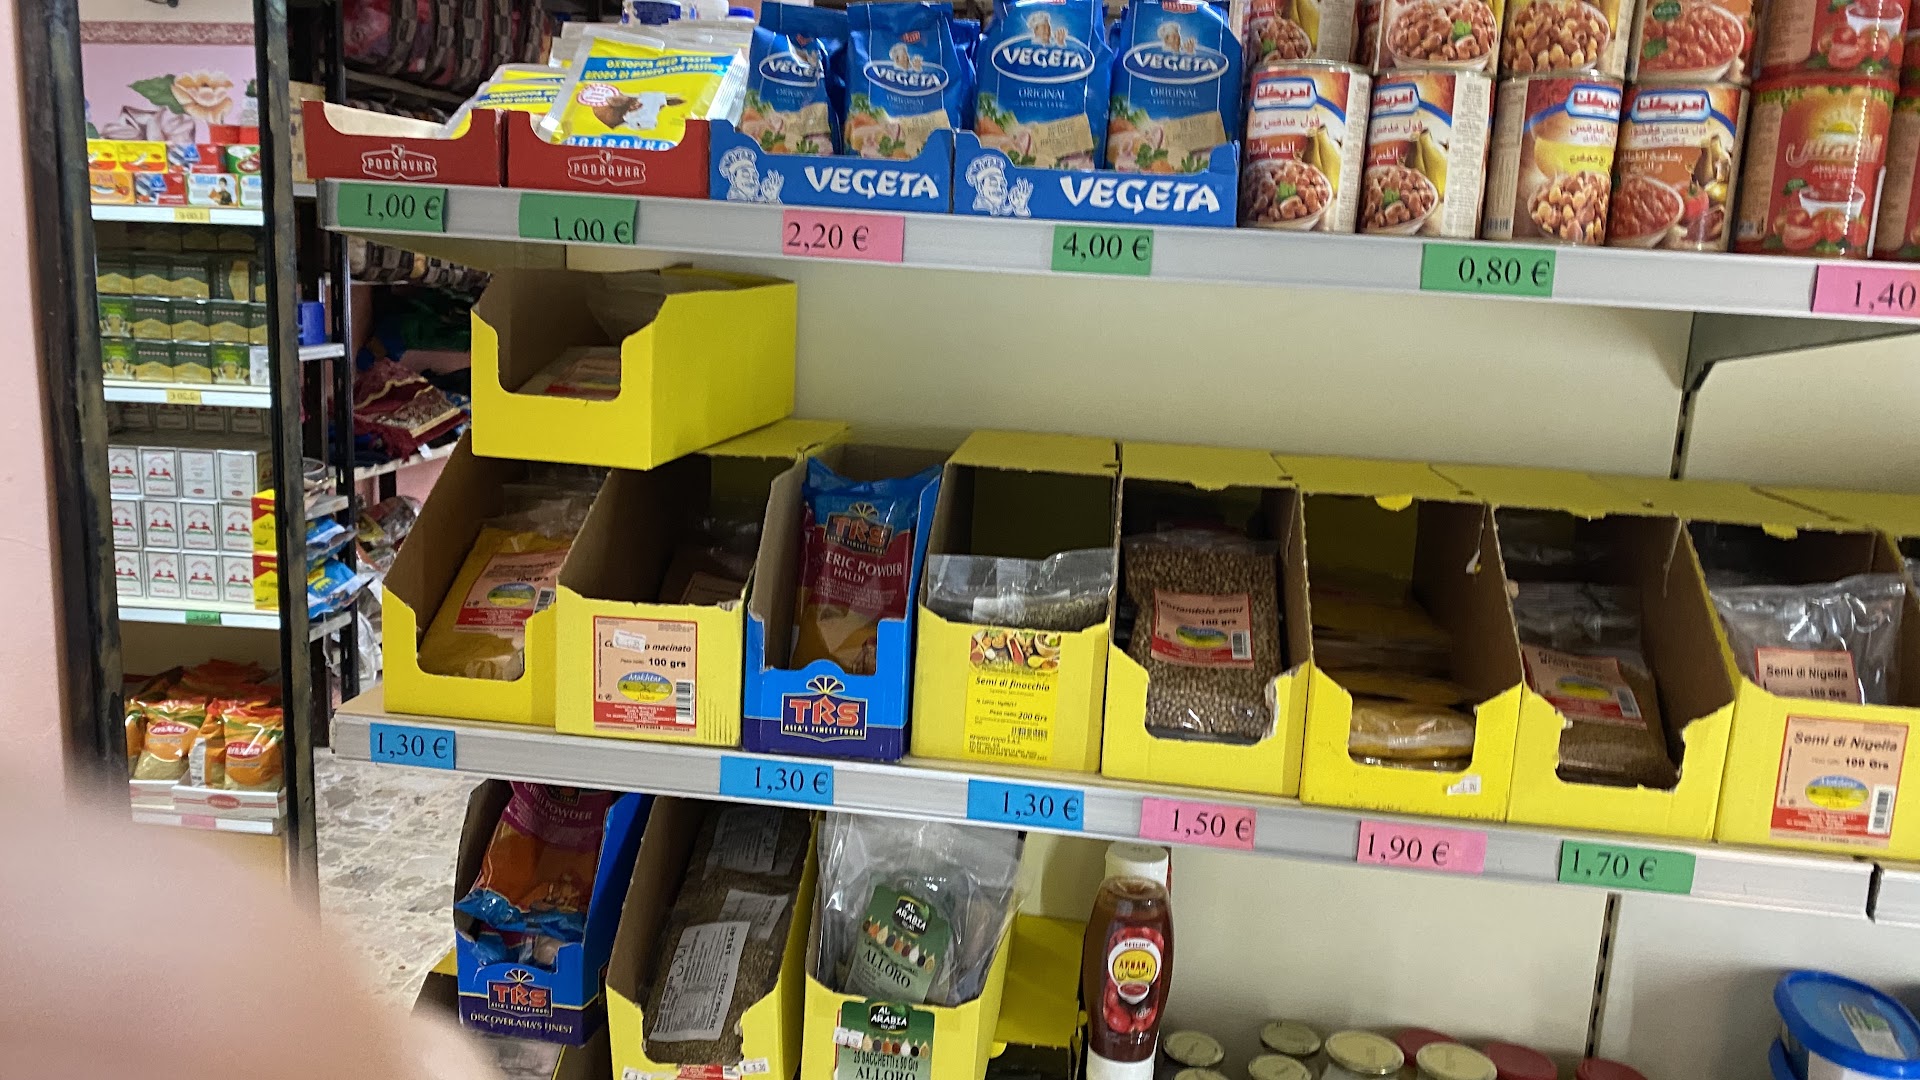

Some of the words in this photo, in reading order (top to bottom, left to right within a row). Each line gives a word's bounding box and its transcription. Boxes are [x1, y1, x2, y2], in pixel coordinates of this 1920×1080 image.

[767, 59, 820, 77] VEGE
[1002, 47, 1087, 69] VEGETA
[1134, 52, 1219, 72] VEGETA
[872, 64, 941, 87] VEGETA
[1019, 86, 1066, 100] ORIGINAL
[1149, 86, 1199, 100] ORIGINAL
[367, 157, 434, 174] PODRAVKA
[573, 163, 642, 179] PODRAVKA
[804, 166, 939, 200] VEGETA
[1060, 176, 1221, 215] VEGETA
[364, 193, 416, 220] 1,00
[425, 196, 441, 220] €
[614, 220, 630, 243] €
[787, 221, 843, 253] 2,20
[852, 225, 870, 252] €
[1063, 231, 1122, 264] 4,00
[1132, 234, 1150, 262] €
[1458, 256, 1521, 287] 0,80
[1531, 258, 1550, 287] €
[1853, 279, 1918, 314] 1,40
[833, 517, 886, 548] TRS
[834, 567, 865, 583] HALDI
[858, 559, 903, 577] POWDER
[652, 643, 692, 653] macinato
[648, 657, 667, 667] 100
[670, 660, 686, 669] grs
[1766, 664, 1794, 679] Semi
[1796, 667, 1806, 679] di
[1808, 667, 1848, 683] Nigella
[975, 676, 998, 687] Semi
[999, 677, 1009, 687] di
[1008, 680, 1051, 692] finocchio
[789, 695, 860, 727] TRS
[1018, 711, 1033, 721] 200
[784, 724, 808, 733] ASIA'S
[377, 732, 425, 759] 1,30
[433, 736, 448, 760] €
[1794, 730, 1830, 747] Semi
[1833, 735, 1847, 748] di
[1850, 736, 1899, 752] Nigella
[1846, 757, 1865, 769] 100
[755, 766, 804, 795] 1,30
[813, 771, 829, 795] €
[545, 803, 593, 820] POWDER
[1004, 790, 1054, 820] 1,30
[1063, 796, 1079, 821] €
[1171, 808, 1227, 839] 1,50
[1236, 817, 1252, 842] €
[1368, 833, 1422, 864] 1,90
[1432, 840, 1449, 866] €
[1573, 849, 1629, 880] 1,70
[1639, 856, 1657, 882] €
[904, 902, 916, 914] AL
[895, 907, 927, 932] ARABIA
[863, 949, 911, 989] ALLORO
[492, 983, 547, 1008] TRS
[470, 1012, 514, 1027] DISCOVER
[514, 1019, 542, 1030] ASIA'S
[870, 1014, 907, 1027] ARABIA
[878, 1006, 891, 1015] AL
[861, 1052, 895, 1069] SACCHETTI
[856, 1066, 917, 1080] ALLORO
